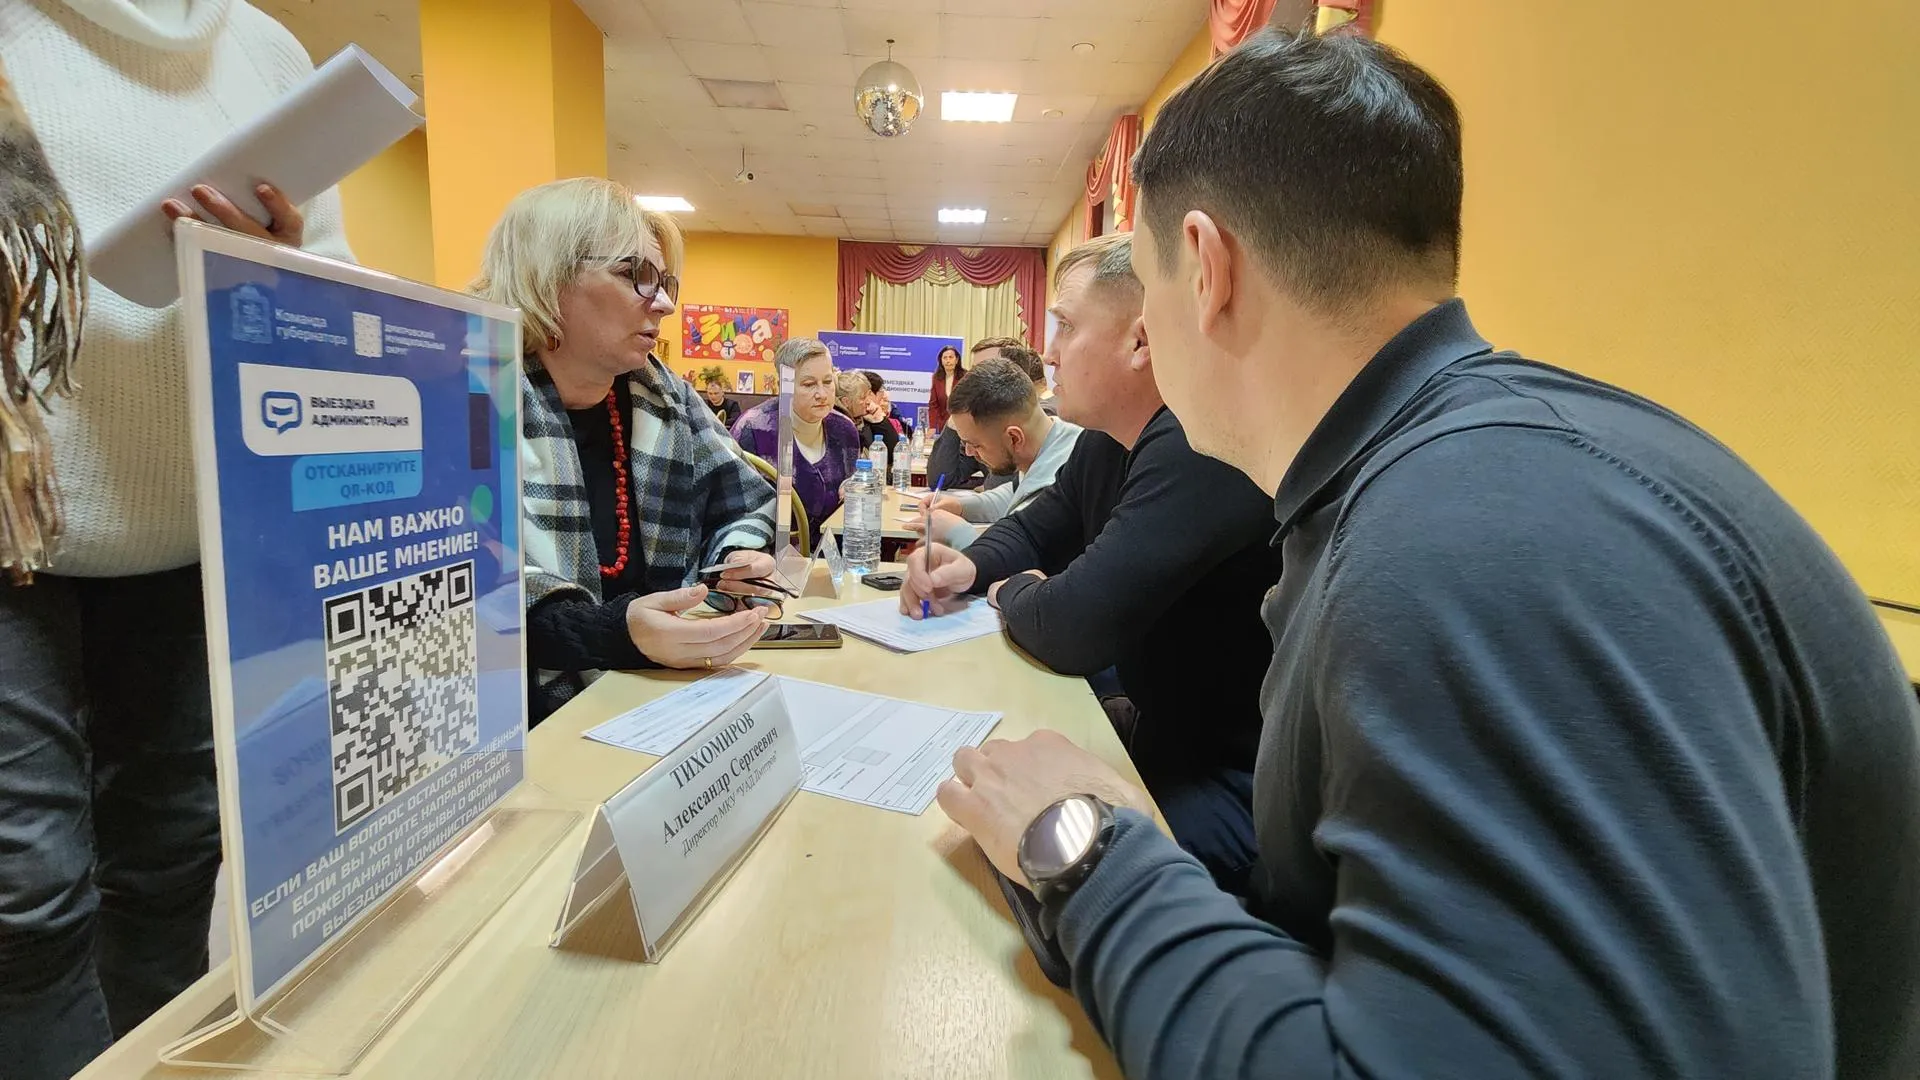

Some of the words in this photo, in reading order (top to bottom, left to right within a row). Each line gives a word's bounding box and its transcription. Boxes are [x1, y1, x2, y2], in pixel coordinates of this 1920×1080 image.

[310, 396, 375, 411] ВЫЕЗДНАЯ
[311, 414, 410, 428] АДМИНИСТРАЦИЯ
[304, 458, 417, 481] ОТСКАНИРУЙТЕ
[340, 480, 395, 499] QR-КОД
[313, 550, 389, 589] ВАШЕ
[395, 531, 478, 569] МНЕНИЕ!
[327, 517, 384, 550] НАМ
[390, 505, 464, 538] ВАЖНО
[669, 711, 755, 790] ТИХОМИРОВ
[663, 771, 731, 845] Александр
[729, 726, 779, 778] Сергеевич
[250, 872, 301, 919] ЕСЛИ
[305, 843, 345, 881] ВАШ
[349, 802, 405, 852] ВОПРОС
[407, 767, 458, 811] ОСТАЛСЯ
[291, 871, 337, 915] ЕСЛИ
[340, 851, 364, 879] ВЫ
[368, 813, 419, 860] ХОТИТЕ
[421, 769, 483, 821] НАПРАВИТЬ
[291, 853, 391, 940] ПОЖЕЛАНИЯ
[394, 844, 404, 862] И
[406, 803, 456, 852] ОТЗЫВЫ
[458, 796, 466, 811] О
[468, 761, 513, 803] ФОРМАТЕ
[682, 814, 719, 858] Директор
[718, 792, 737, 819] МКУ
[322, 862, 403, 939] ВЫЕЗДНОЙ
[406, 788, 498, 872] АДМИНИСТРАЦИИ
